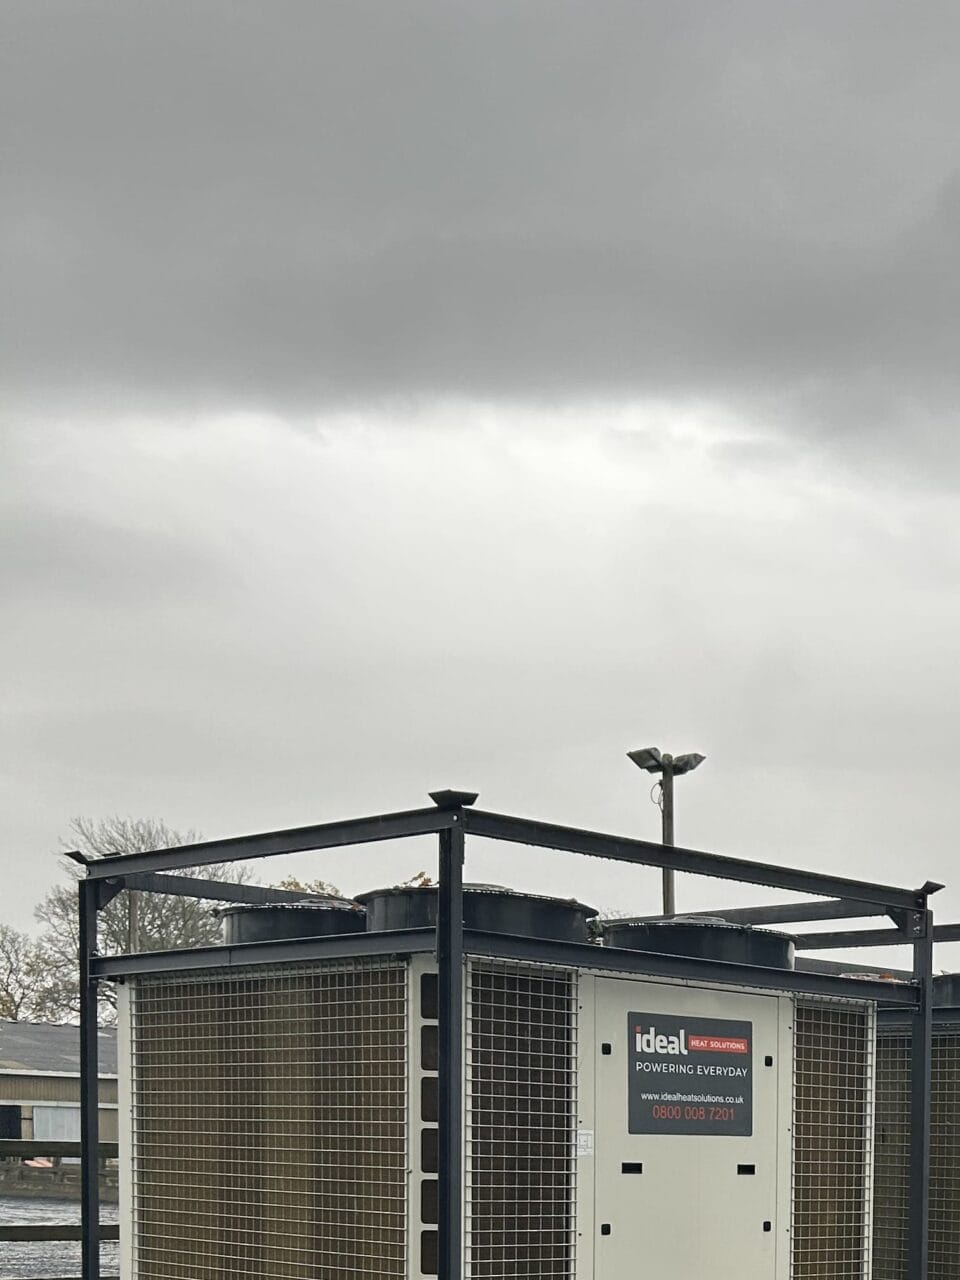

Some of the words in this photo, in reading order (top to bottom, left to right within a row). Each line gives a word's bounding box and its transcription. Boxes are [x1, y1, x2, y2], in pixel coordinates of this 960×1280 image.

[635, 1025, 688, 1055] ideal
[691, 1039, 709, 1048] HEAT
[710, 1041, 745, 1050] SOLUTIONS
[636, 1061, 694, 1074] POWERING
[697, 1065, 747, 1077] EVERYDAY
[640, 1092, 744, 1104] www.idealheatsolutions.co.uk
[653, 1105, 681, 1119] 0800
[684, 1106, 706, 1120] 008
[709, 1107, 735, 1120] 7201
